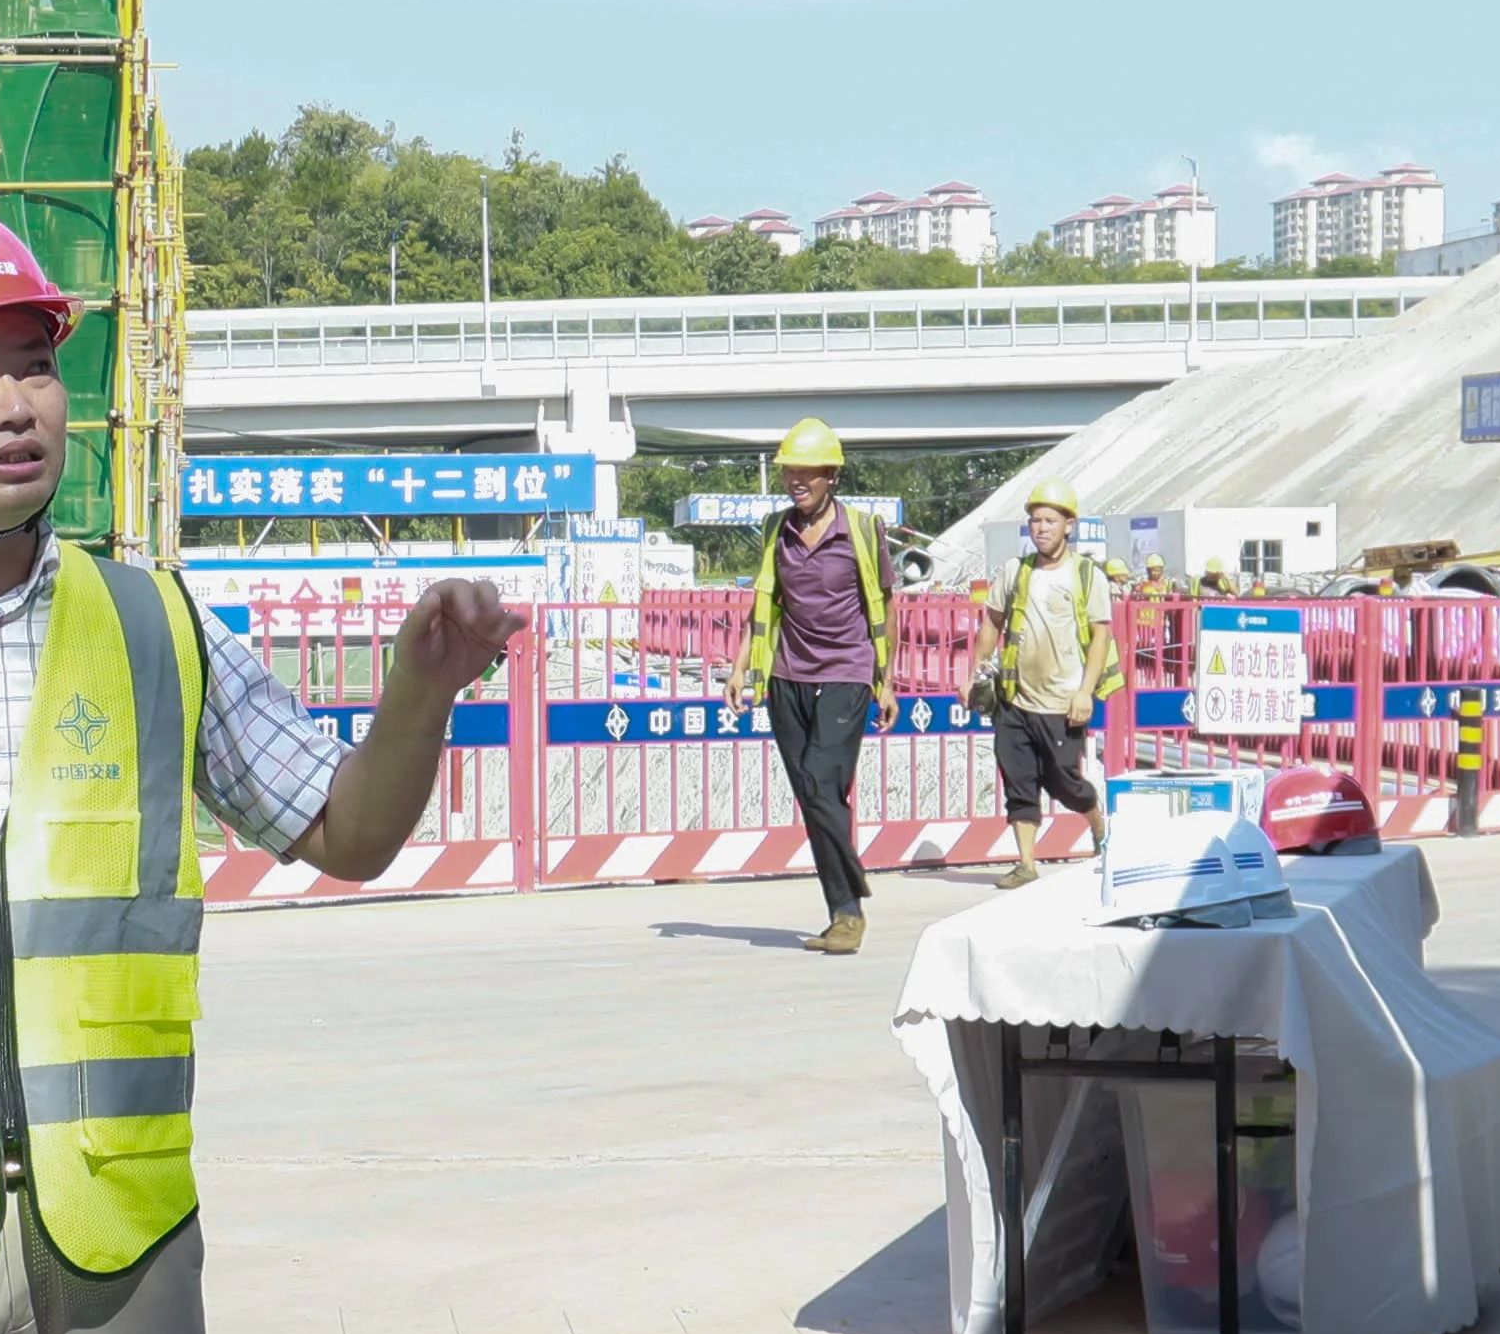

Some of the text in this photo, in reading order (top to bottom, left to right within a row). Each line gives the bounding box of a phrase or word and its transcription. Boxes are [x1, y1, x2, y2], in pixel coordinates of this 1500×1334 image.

[1231, 642, 1297, 680] 临边危险
[649, 707, 773, 736] 中国交建
[1229, 687, 1296, 724] 请勿靠近
[51, 763, 121, 780] 中国交建
